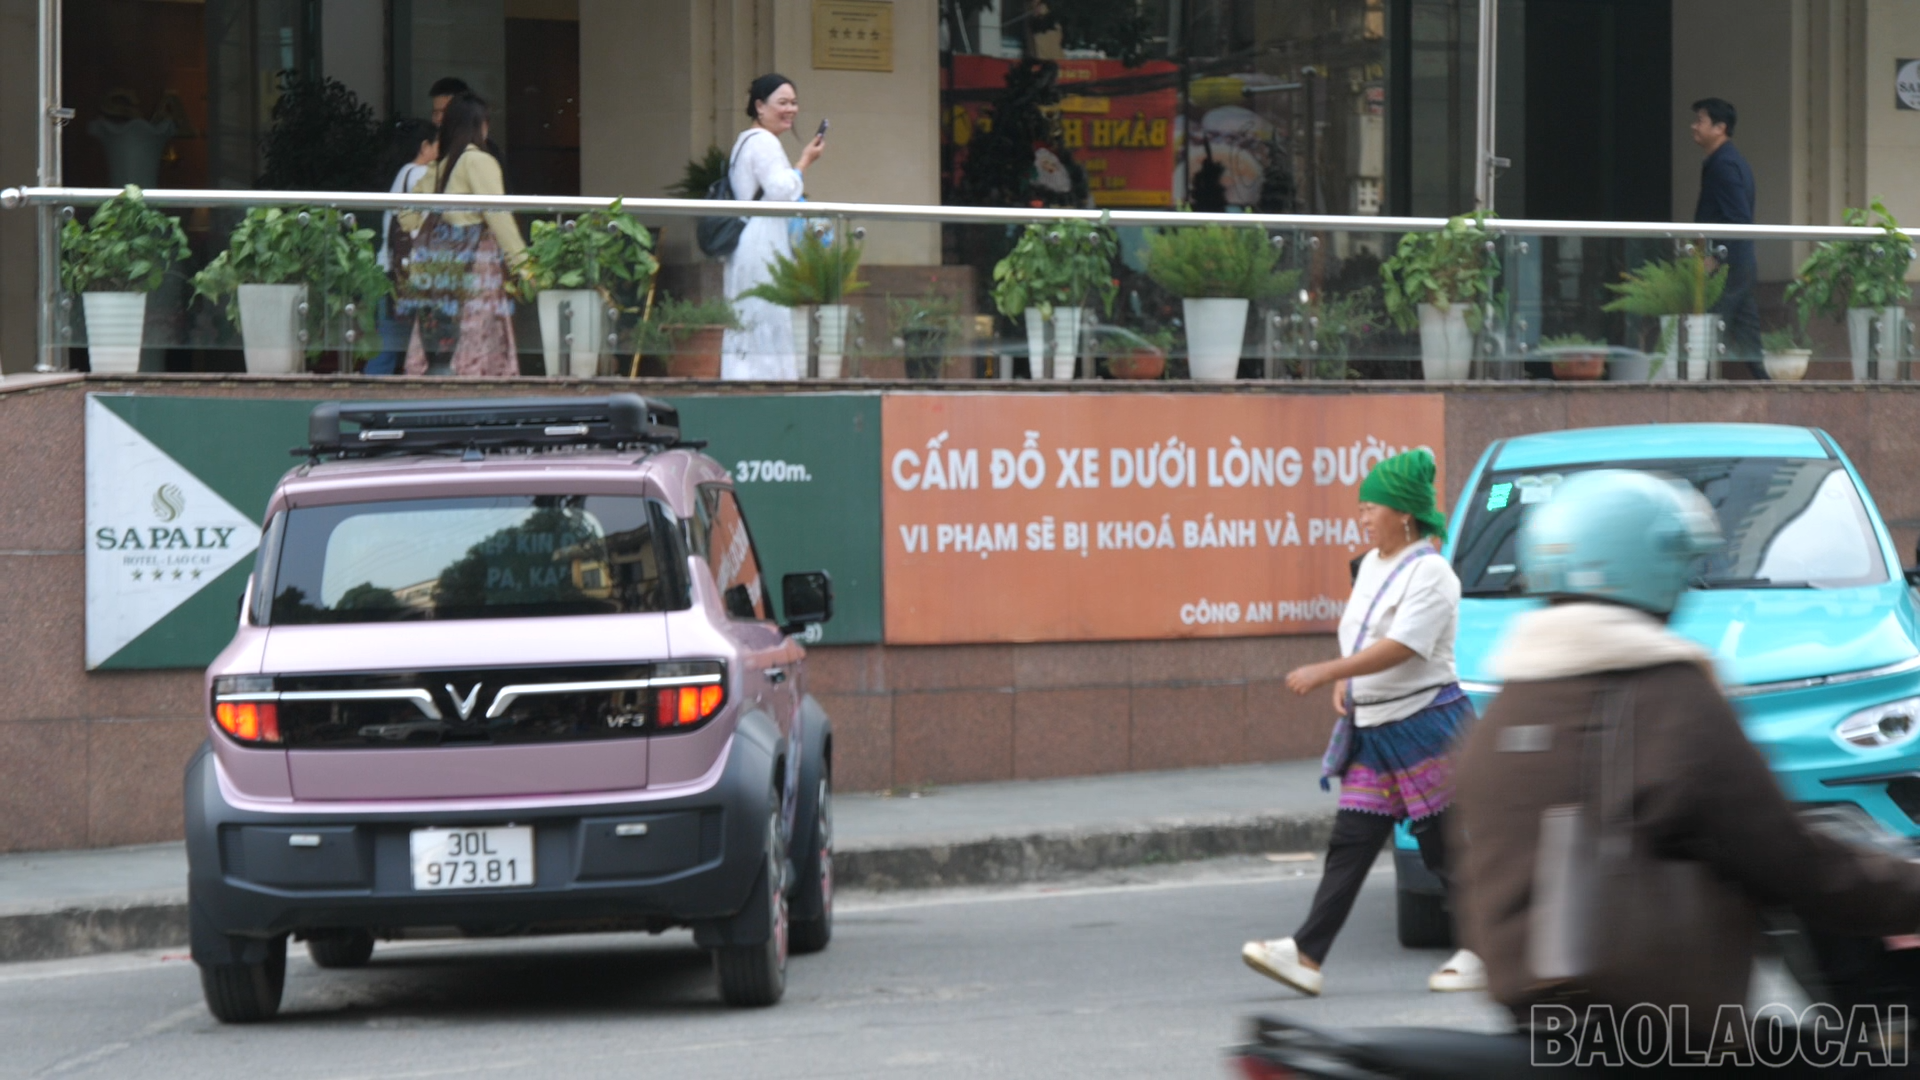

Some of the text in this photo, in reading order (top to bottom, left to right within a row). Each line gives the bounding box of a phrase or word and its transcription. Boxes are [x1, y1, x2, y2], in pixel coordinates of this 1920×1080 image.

[736, 460, 812, 482] 3700m.
[891, 430, 1436, 491] CẤM ĐỖ XE DƯỚI LÒNG ĐƯỜ
[95, 527, 236, 550] SAPALY
[900, 523, 929, 552] VI
[937, 522, 1018, 559] PHẠM
[1025, 516, 1055, 551] SẼ
[1063, 521, 1088, 558] BỊ
[1097, 512, 1176, 550] KHOÁ
[1183, 512, 1256, 549] BÁNH
[1263, 511, 1301, 547] VÀ
[1180, 594, 1347, 625] CÔNG AN PHƯỜN
[448, 831, 497, 856] 30L
[427, 858, 516, 885] 973.81
